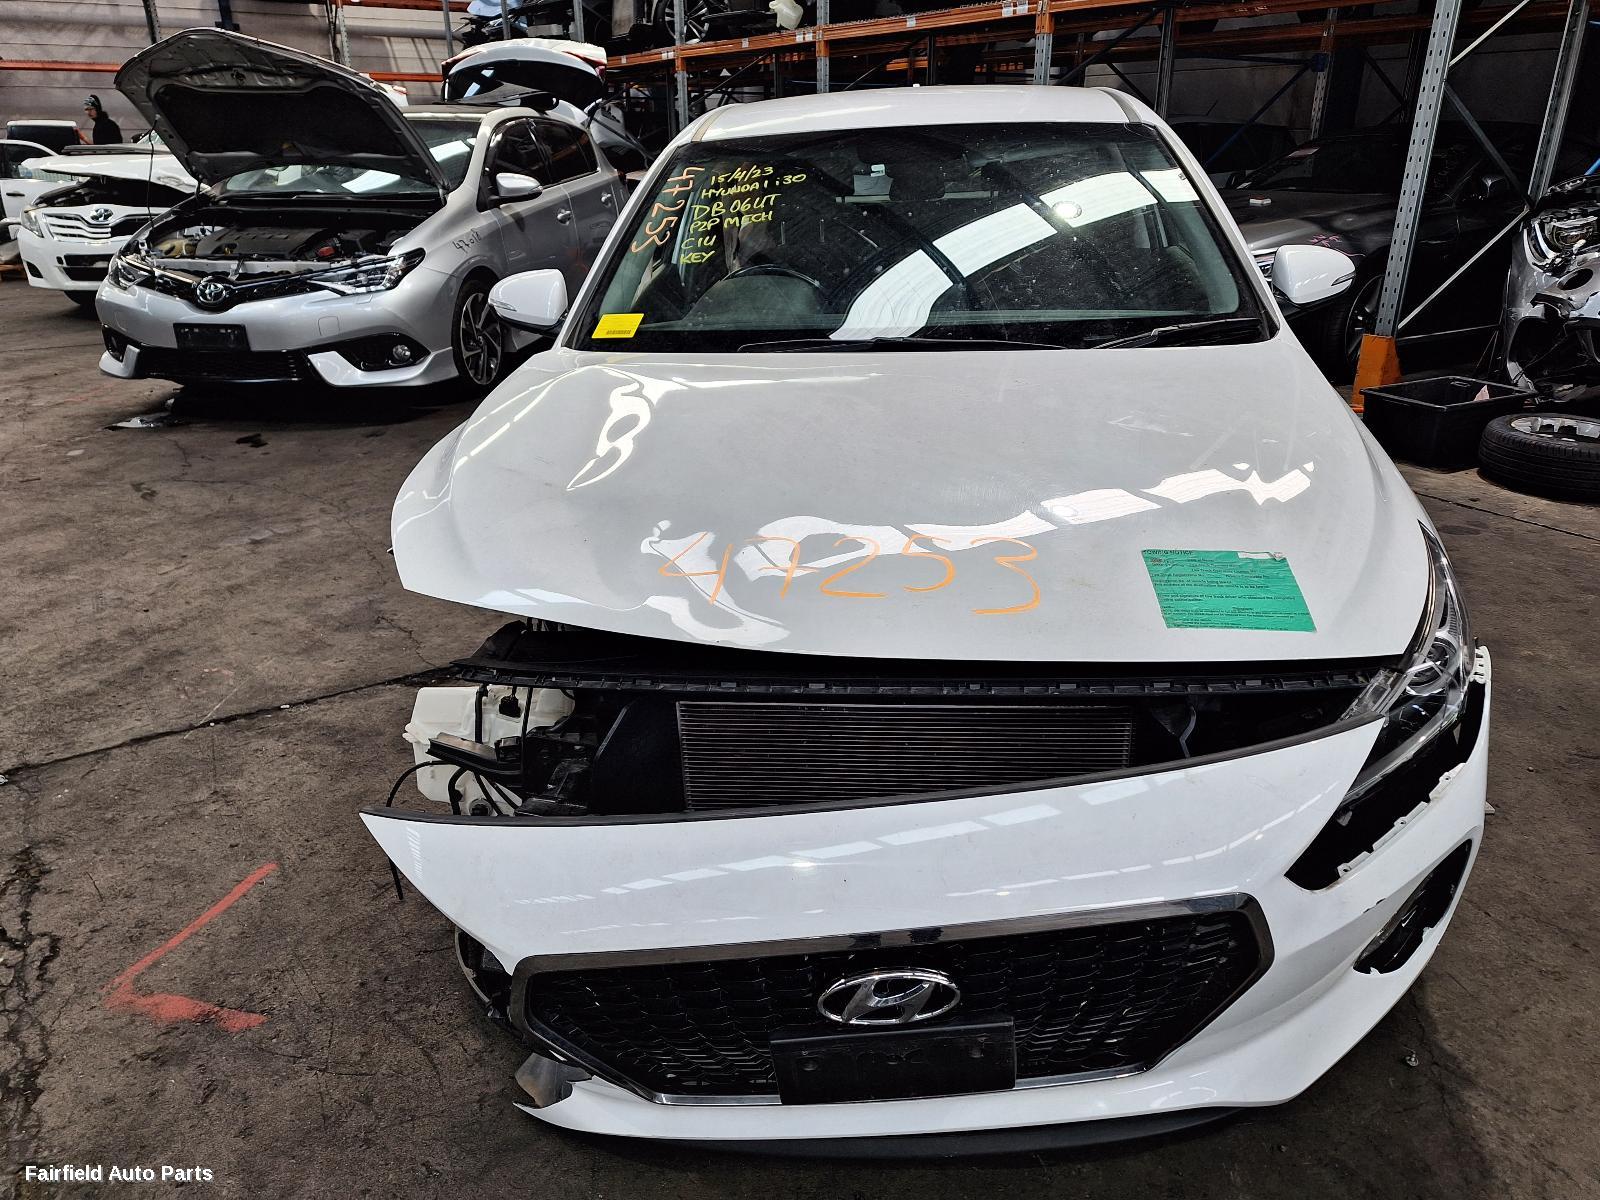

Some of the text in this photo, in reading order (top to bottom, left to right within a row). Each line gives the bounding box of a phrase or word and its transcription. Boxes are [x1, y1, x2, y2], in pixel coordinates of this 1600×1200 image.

[710, 164, 774, 186] 15/4/23
[631, 166, 705, 253] 47253
[723, 210, 774, 229] MECH
[679, 250, 716, 265] KEY
[658, 530, 1042, 616] 47253
